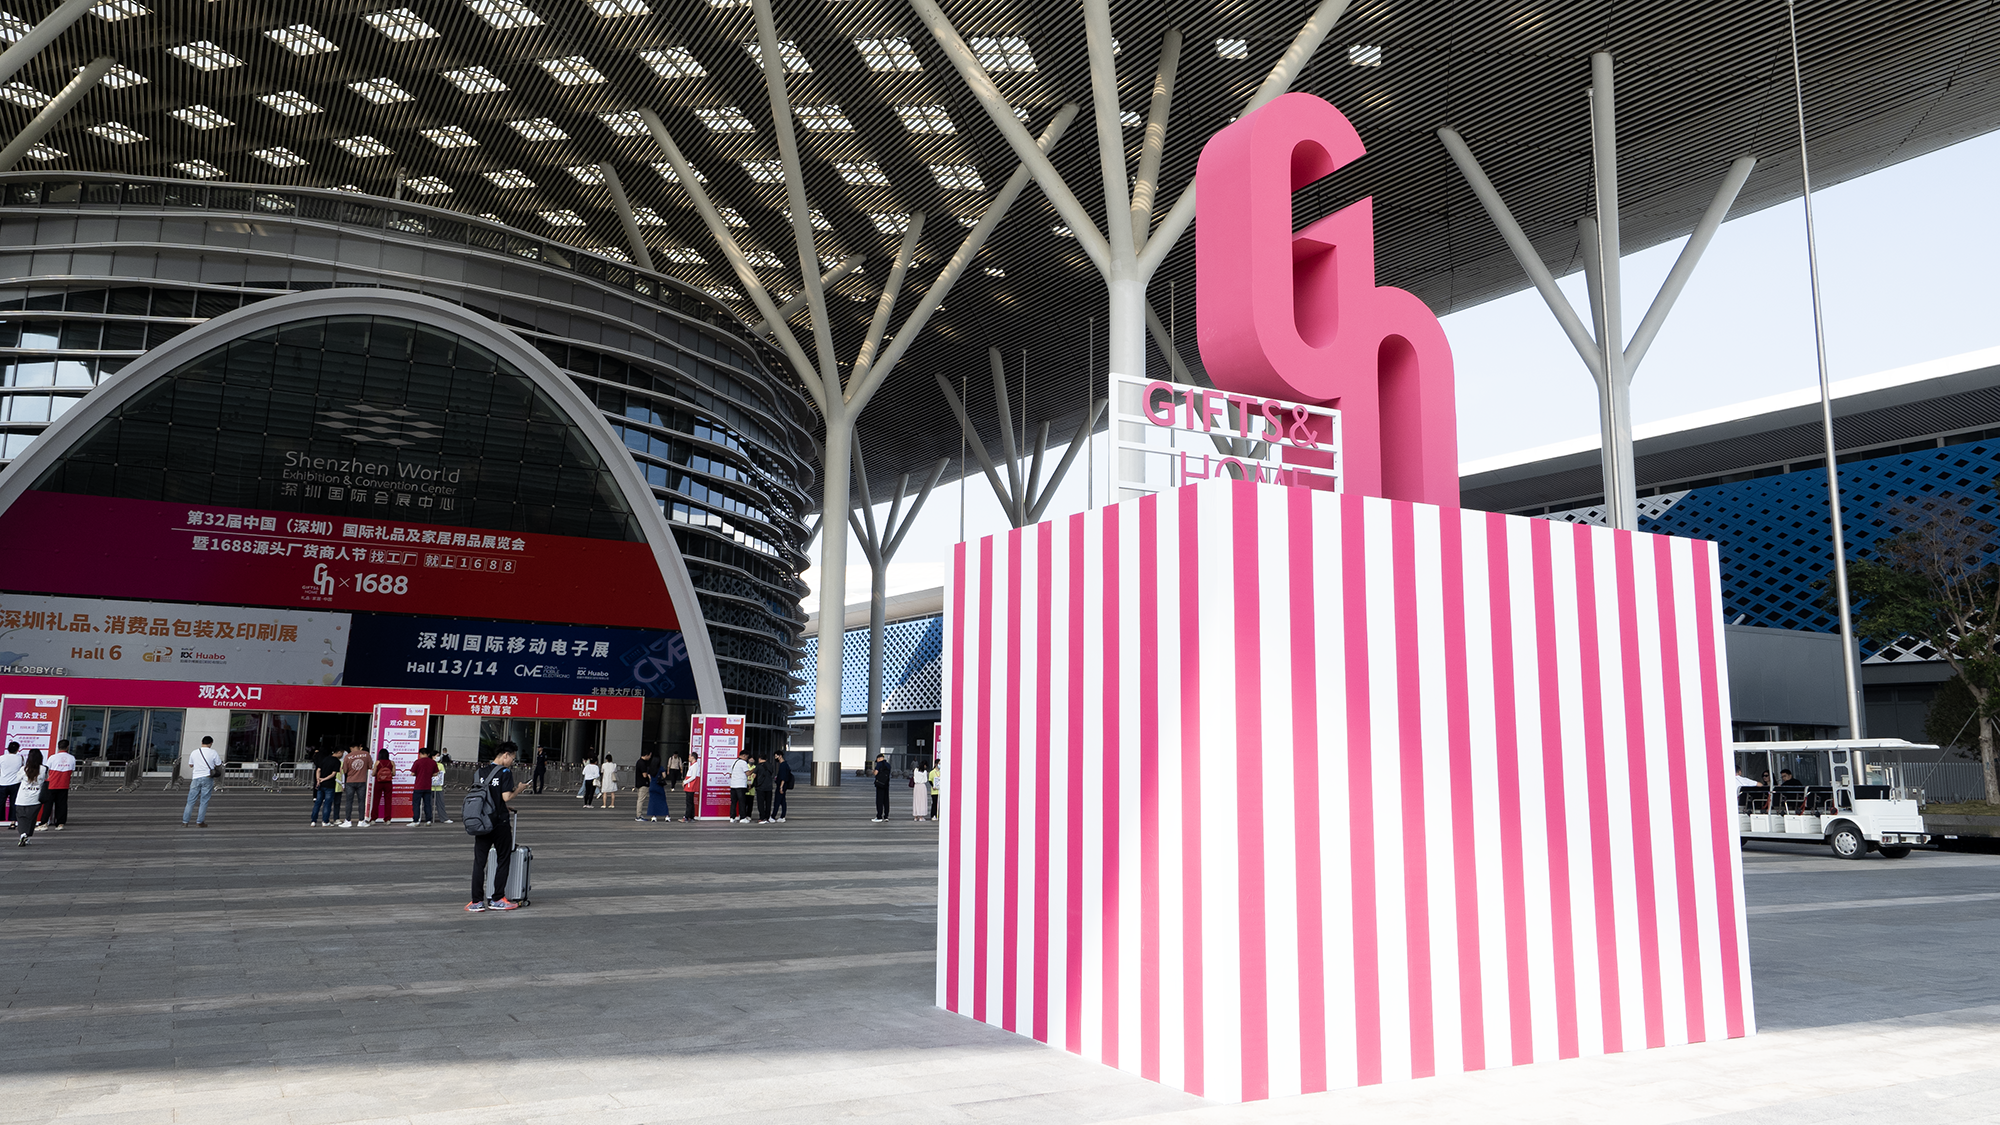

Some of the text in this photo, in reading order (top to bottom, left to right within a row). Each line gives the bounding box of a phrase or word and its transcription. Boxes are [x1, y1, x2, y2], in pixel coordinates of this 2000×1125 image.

[284, 451, 460, 483] Shenzhen World
[283, 469, 457, 495] Exhibition & Convention Center
[281, 482, 455, 511] 深圳国际会展中心
[355, 573, 408, 595] 1688
[71, 645, 122, 660] Hall 6
[417, 631, 610, 659] 深圳国际移动电子展
[195, 652, 226, 660] Huabo
[407, 659, 498, 677] Hall 13/14
[514, 664, 543, 677] CME
[198, 685, 262, 700] 观众入口
[468, 694, 518, 705] 工作人员及
[471, 705, 511, 715] 特邀嘉宾
[572, 698, 598, 712] 出口
[15, 712, 47, 720] 观众登记
